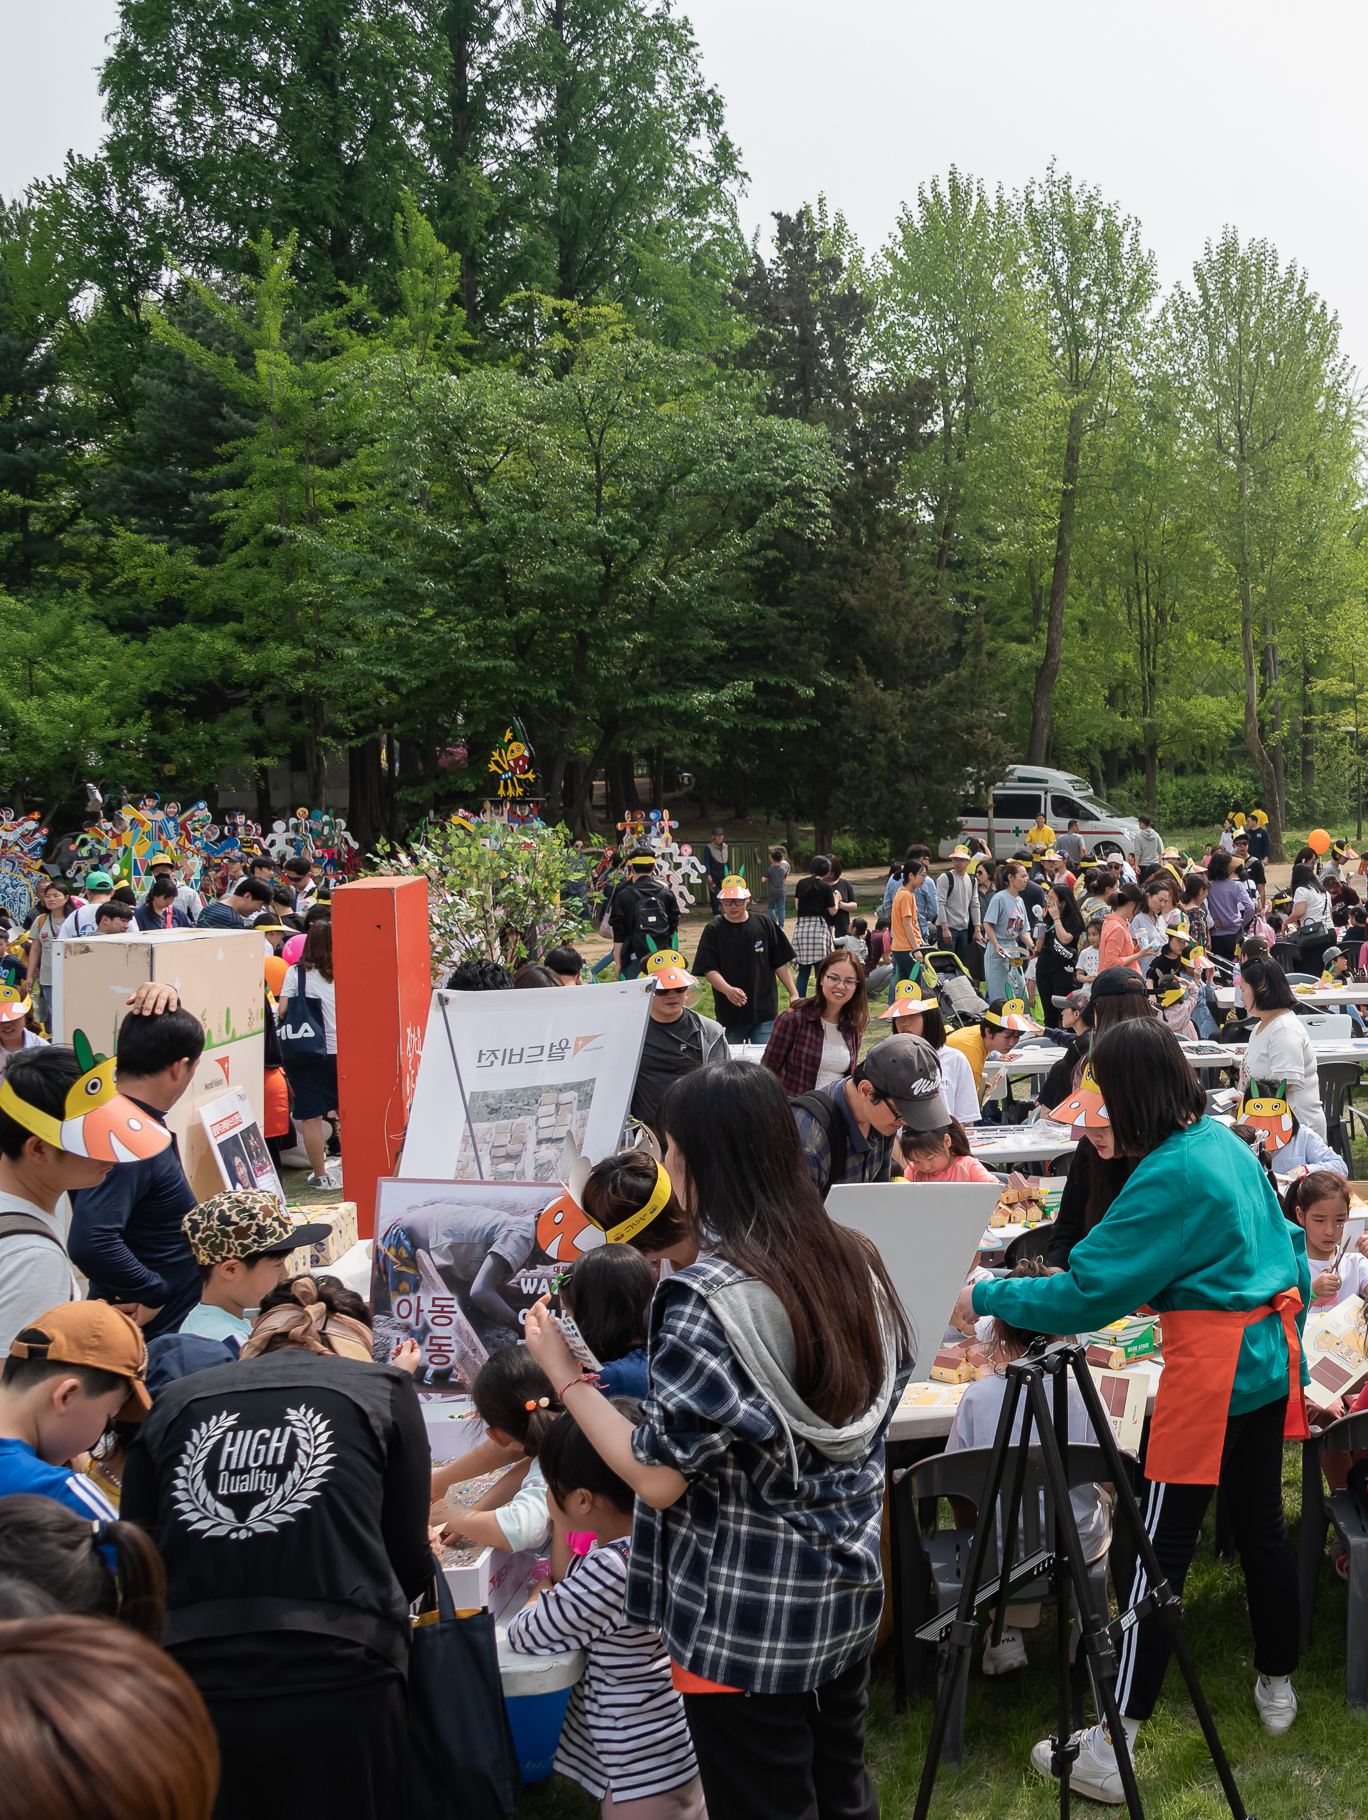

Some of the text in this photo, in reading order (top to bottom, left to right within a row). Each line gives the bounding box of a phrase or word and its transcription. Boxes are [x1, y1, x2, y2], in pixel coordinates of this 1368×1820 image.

[520, 1277, 561, 1295] WAT
[396, 1295, 457, 1327] 아동
[1138, 1342, 1150, 1350] STICK
[218, 1426, 292, 1471] HIGH
[217, 1468, 278, 1496] Quality
